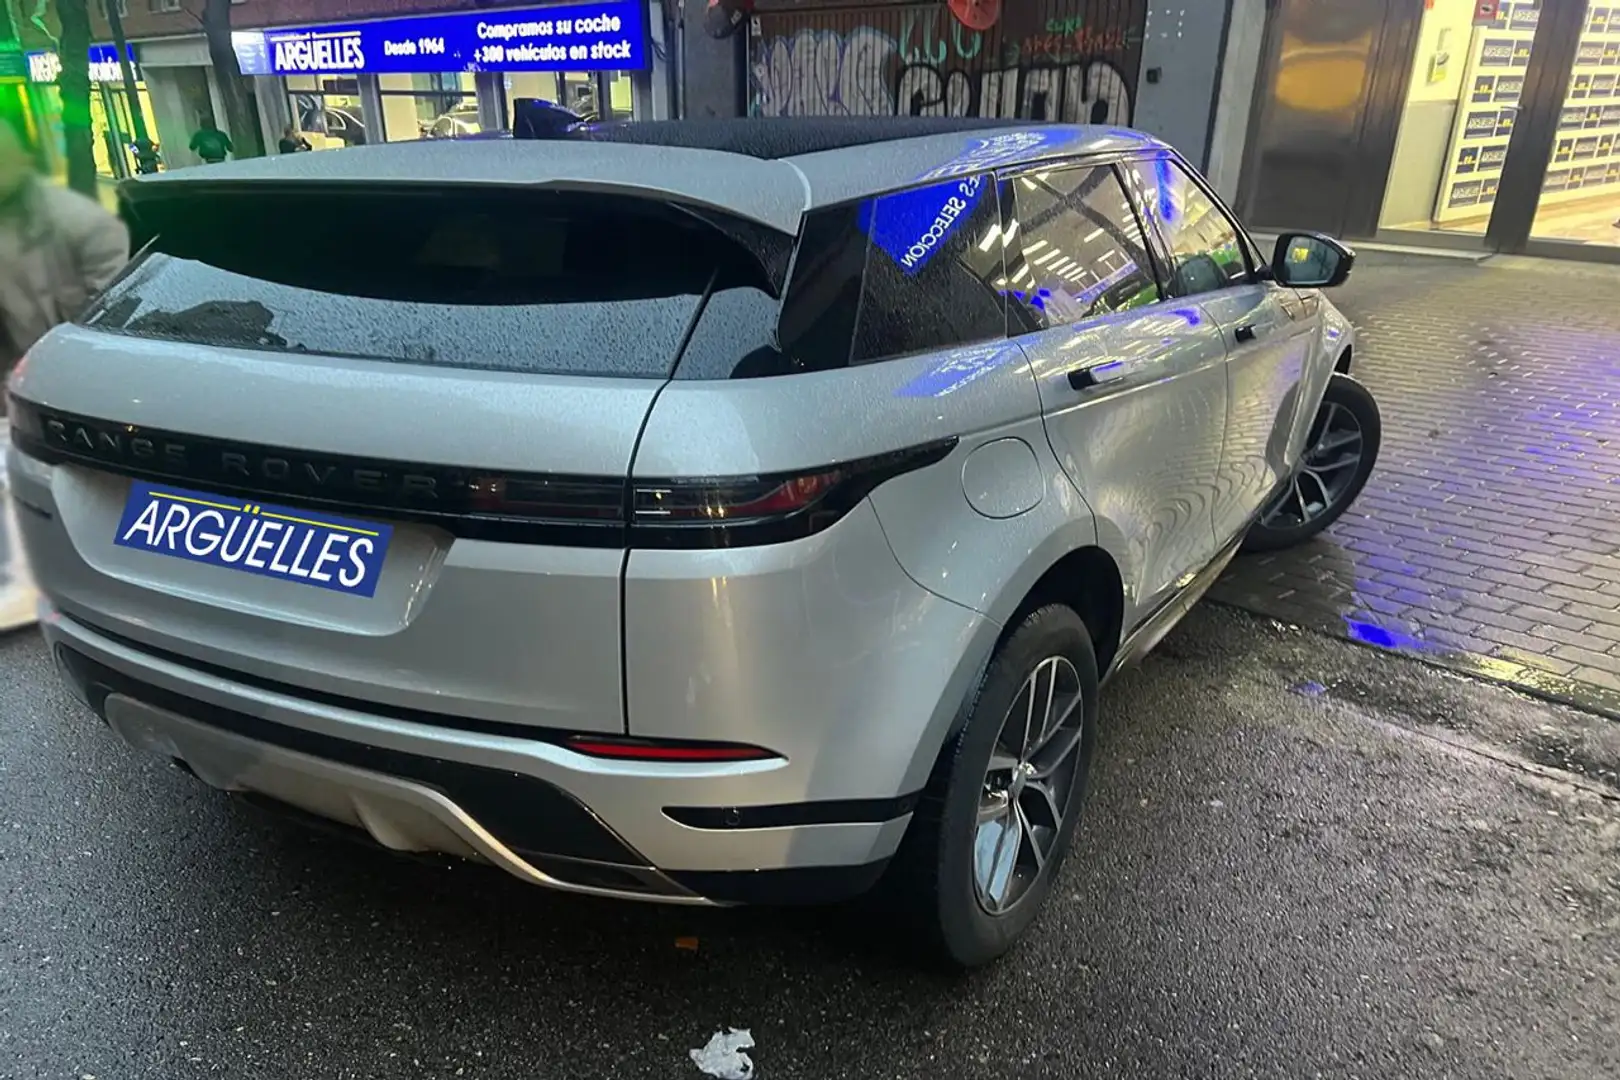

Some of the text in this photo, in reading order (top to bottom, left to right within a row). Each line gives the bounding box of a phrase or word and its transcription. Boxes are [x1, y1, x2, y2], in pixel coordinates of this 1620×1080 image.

[477, 13, 621, 41] Compramos su coche
[384, 37, 445, 56] Desde 1964
[474, 40, 631, 63] +300 vehículos en stock
[48, 420, 439, 498] RANGE ROVER
[122, 500, 374, 587] ARGÜELLES
